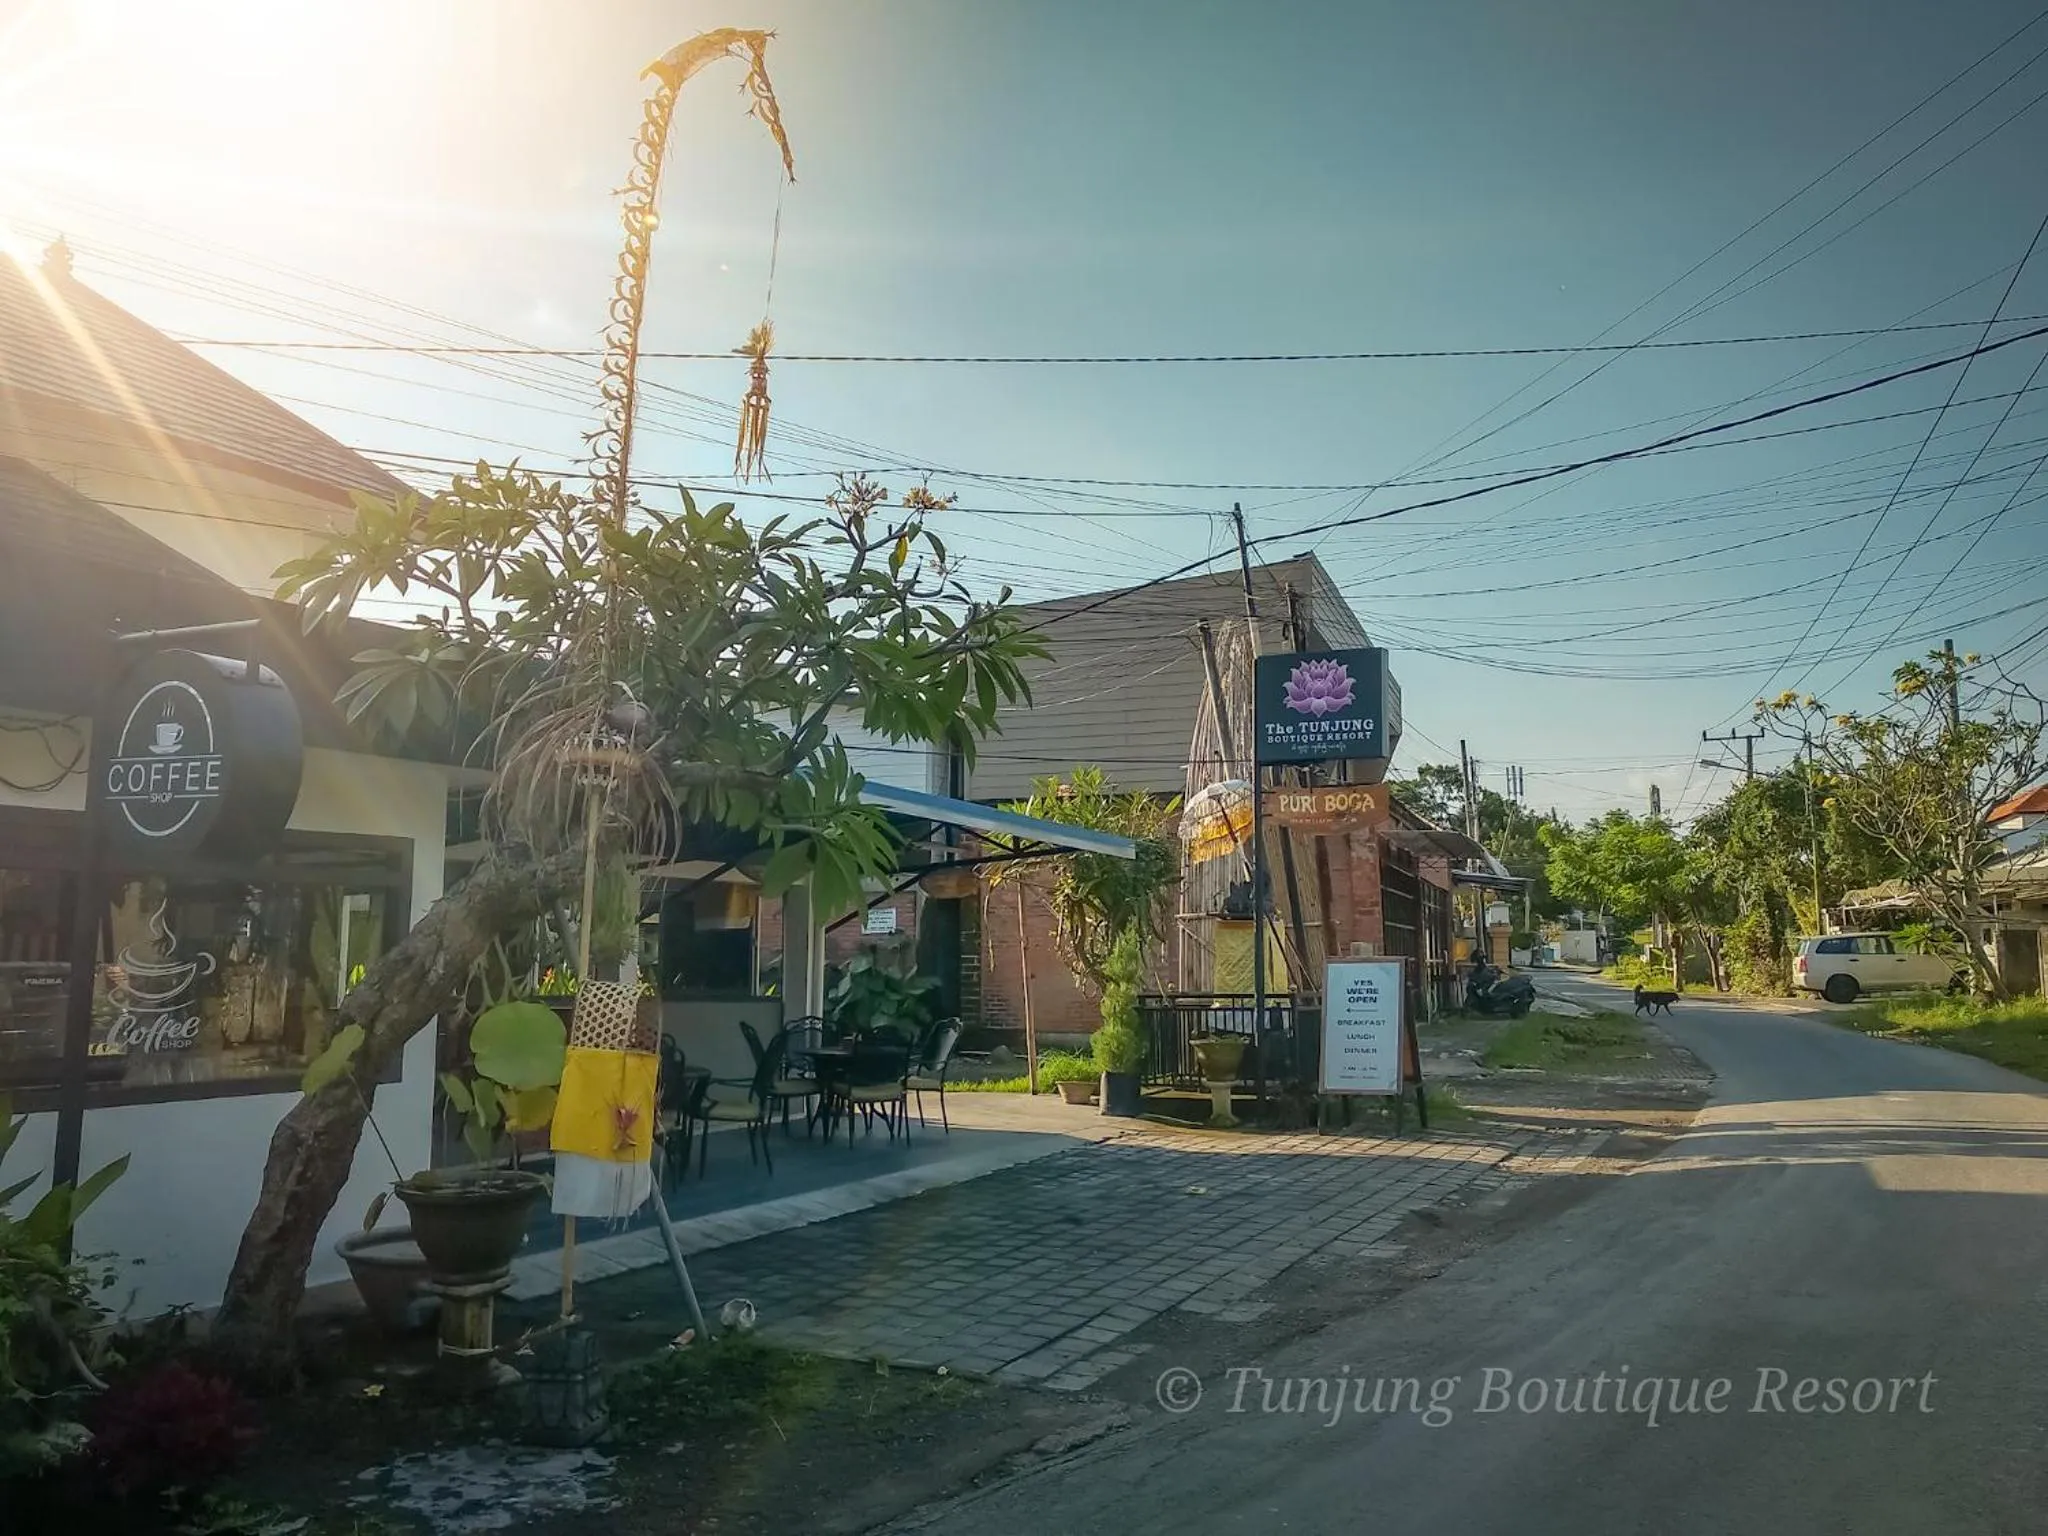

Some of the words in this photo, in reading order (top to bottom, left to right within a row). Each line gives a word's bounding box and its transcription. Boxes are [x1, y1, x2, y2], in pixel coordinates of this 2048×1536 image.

[1265, 723, 1294, 735] The
[1299, 719, 1375, 733] TUNJUNG
[1267, 734, 1323, 744] BOUTIQUE
[1326, 731, 1372, 741] RESORT
[108, 761, 221, 793] COFFEE
[150, 792, 174, 803] SHOP
[1279, 795, 1318, 814] PURI
[1324, 793, 1375, 813] BOGA
[106, 1012, 201, 1054] Coffee
[161, 1039, 193, 1050] SHOP
